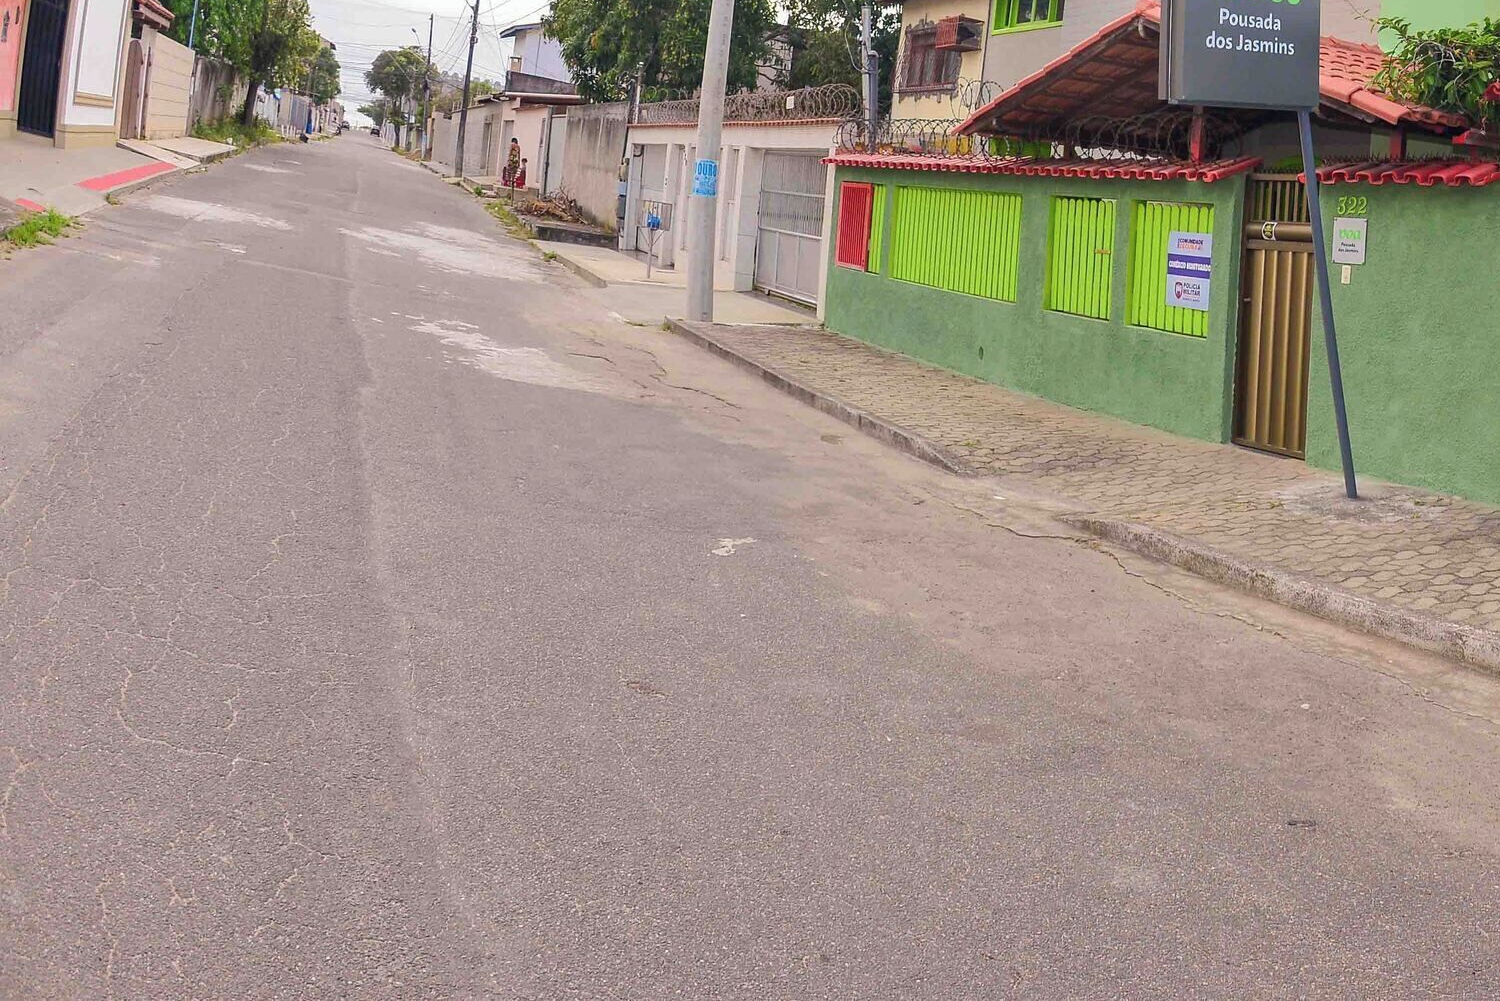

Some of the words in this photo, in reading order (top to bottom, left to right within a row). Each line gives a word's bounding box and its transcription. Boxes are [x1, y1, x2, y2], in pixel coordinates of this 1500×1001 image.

[1219, 7, 1281, 31] Pousada
[1205, 30, 1233, 50] dos
[1236, 34, 1295, 56] Jasmins
[1337, 196, 1367, 215] 322
